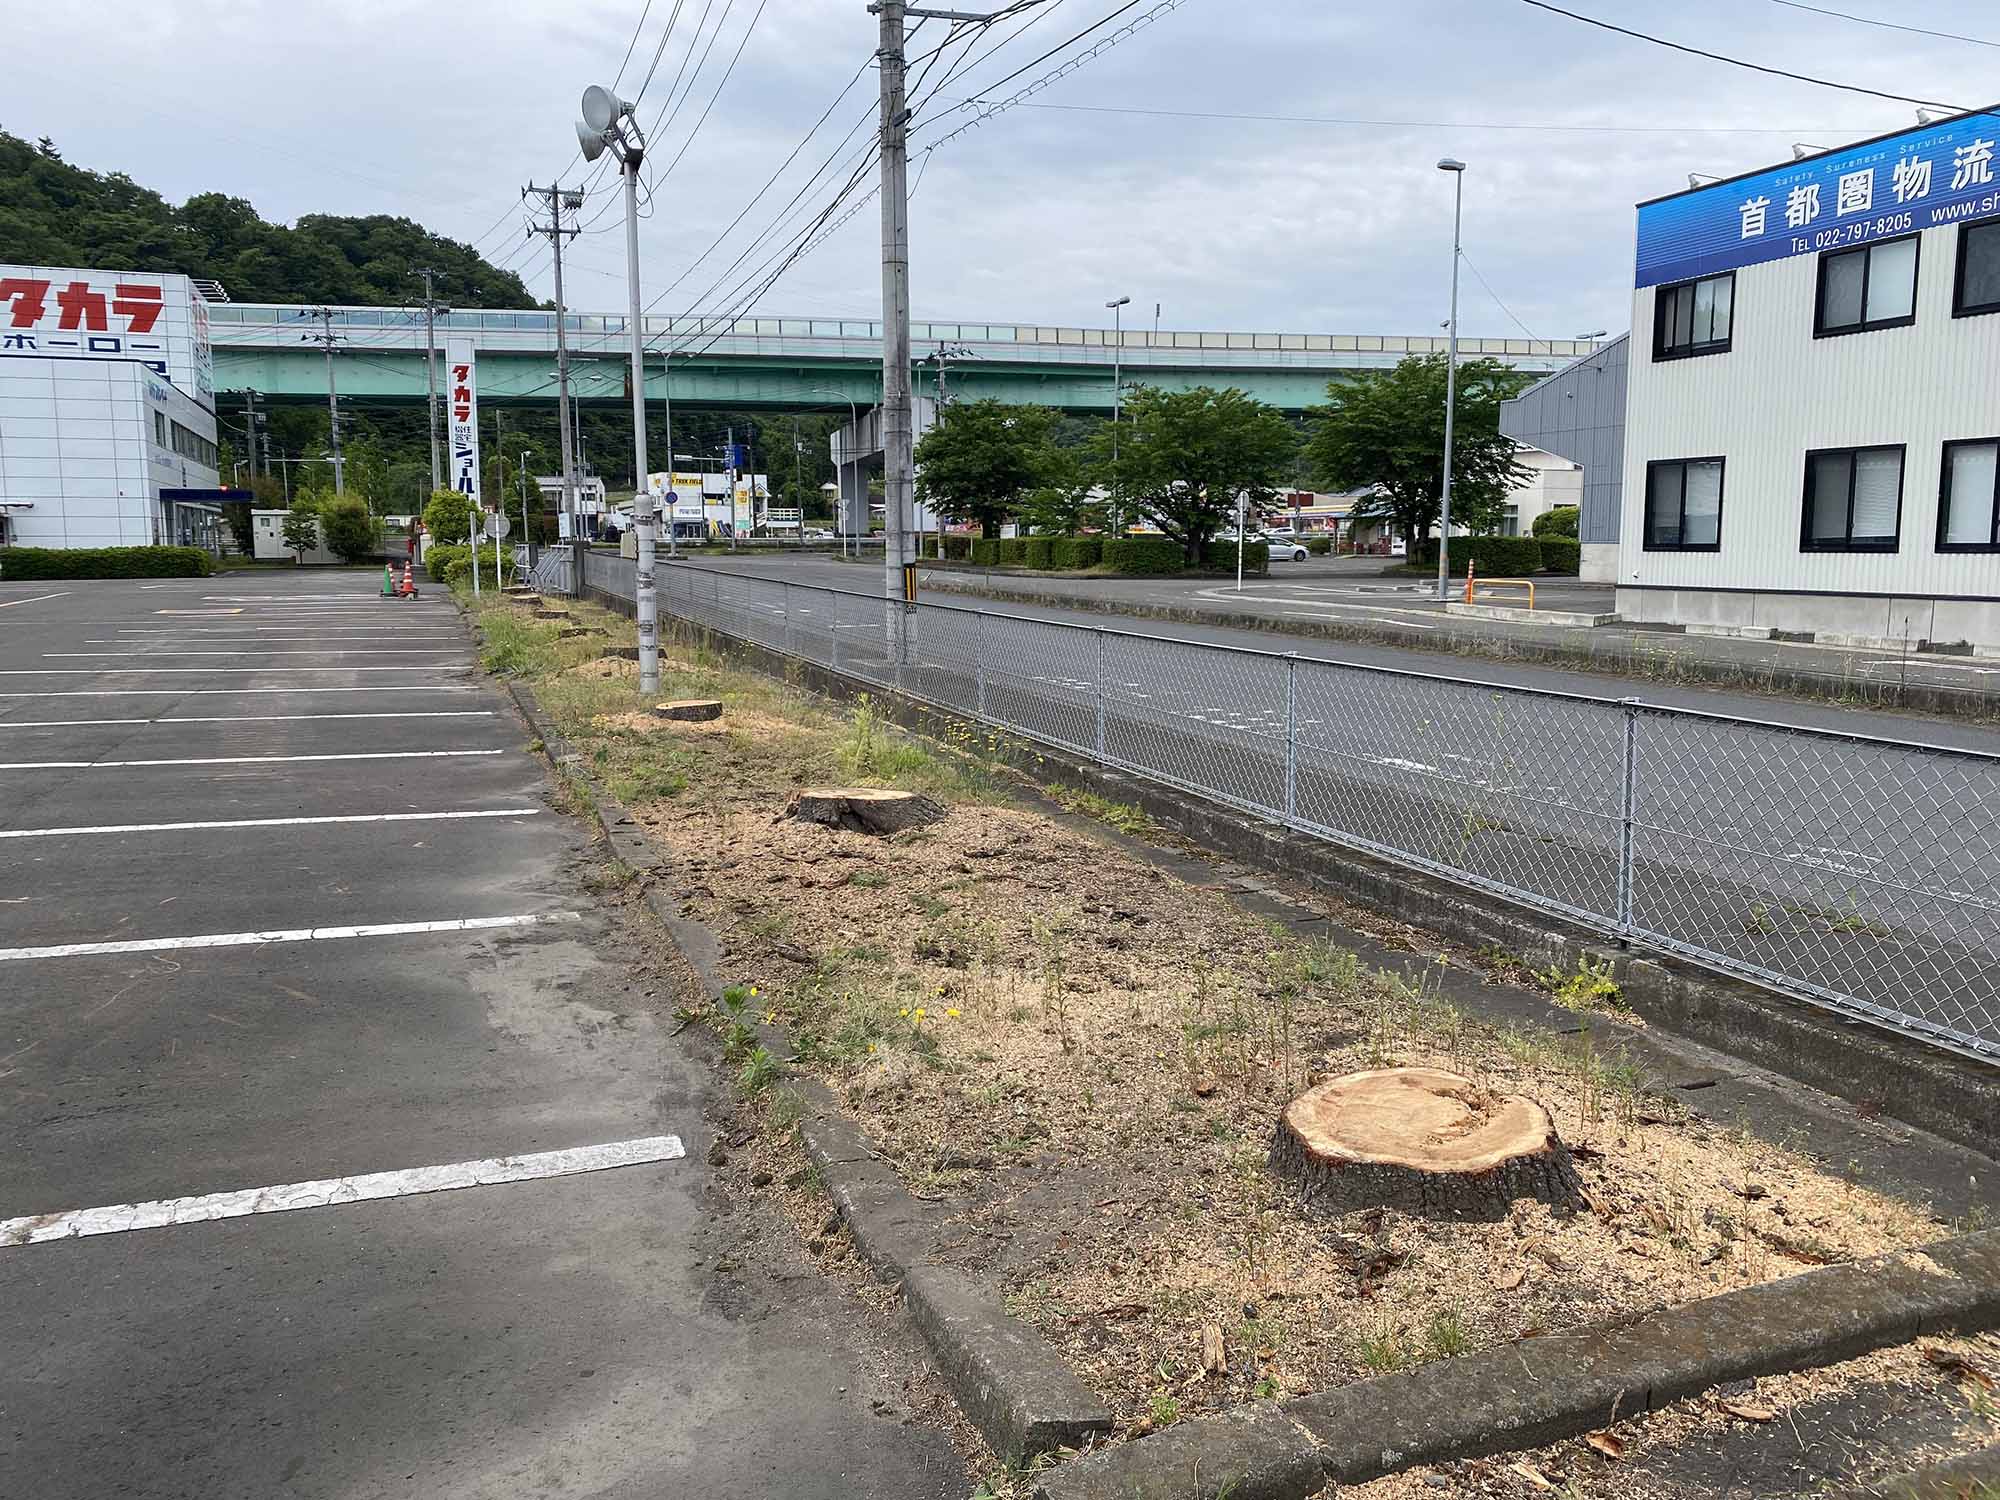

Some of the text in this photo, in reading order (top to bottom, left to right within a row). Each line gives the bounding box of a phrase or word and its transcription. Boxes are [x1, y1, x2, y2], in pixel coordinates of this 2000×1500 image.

[1900, 134, 1953, 154] Service
[1739, 138, 1996, 240] 首都圏物流
[1815, 211, 1913, 249] 022-797-8205
[0, 278, 164, 333] タカラ
[4, 334, 160, 352] ホーロー
[452, 365, 471, 423] タカラ
